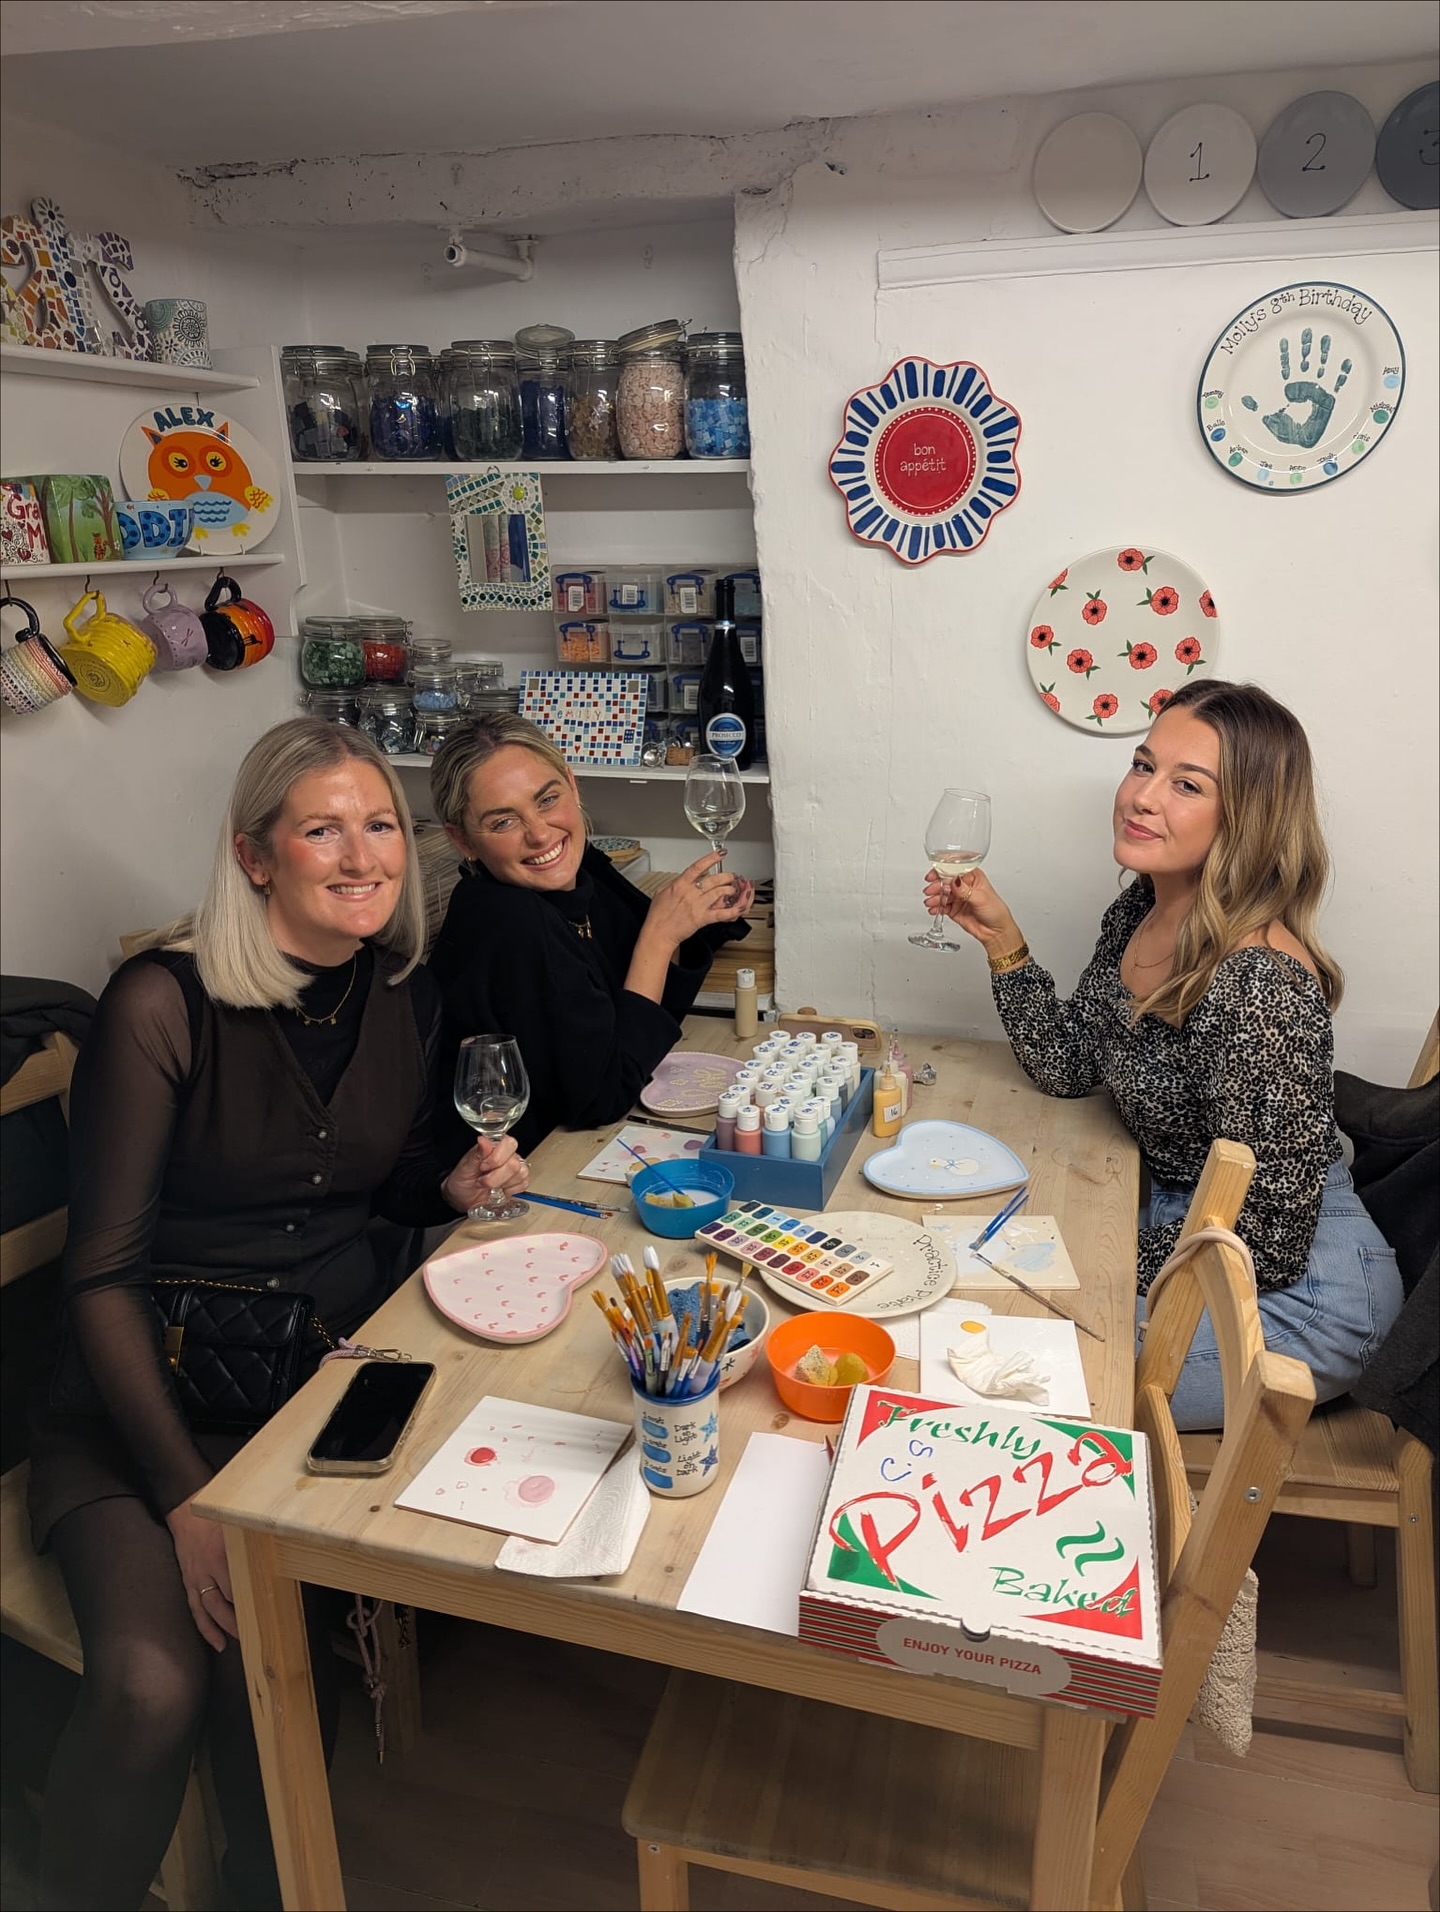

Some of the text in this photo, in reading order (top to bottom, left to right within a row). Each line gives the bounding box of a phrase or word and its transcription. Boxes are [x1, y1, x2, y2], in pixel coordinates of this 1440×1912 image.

[1189, 141, 1210, 182] 1
[1302, 132, 1326, 172] 2
[1299, 288, 1373, 325] Birthday
[153, 406, 215, 432] ALEX
[900, 457, 947, 477] appétit
[913, 442, 936, 456] bon
[877, 1400, 1042, 1460] Freshly
[828, 1431, 1134, 1587] Pizza
[988, 1566, 1138, 1618] Baked
[903, 1637, 1041, 1675] ENJOY YOUR PIZZA
